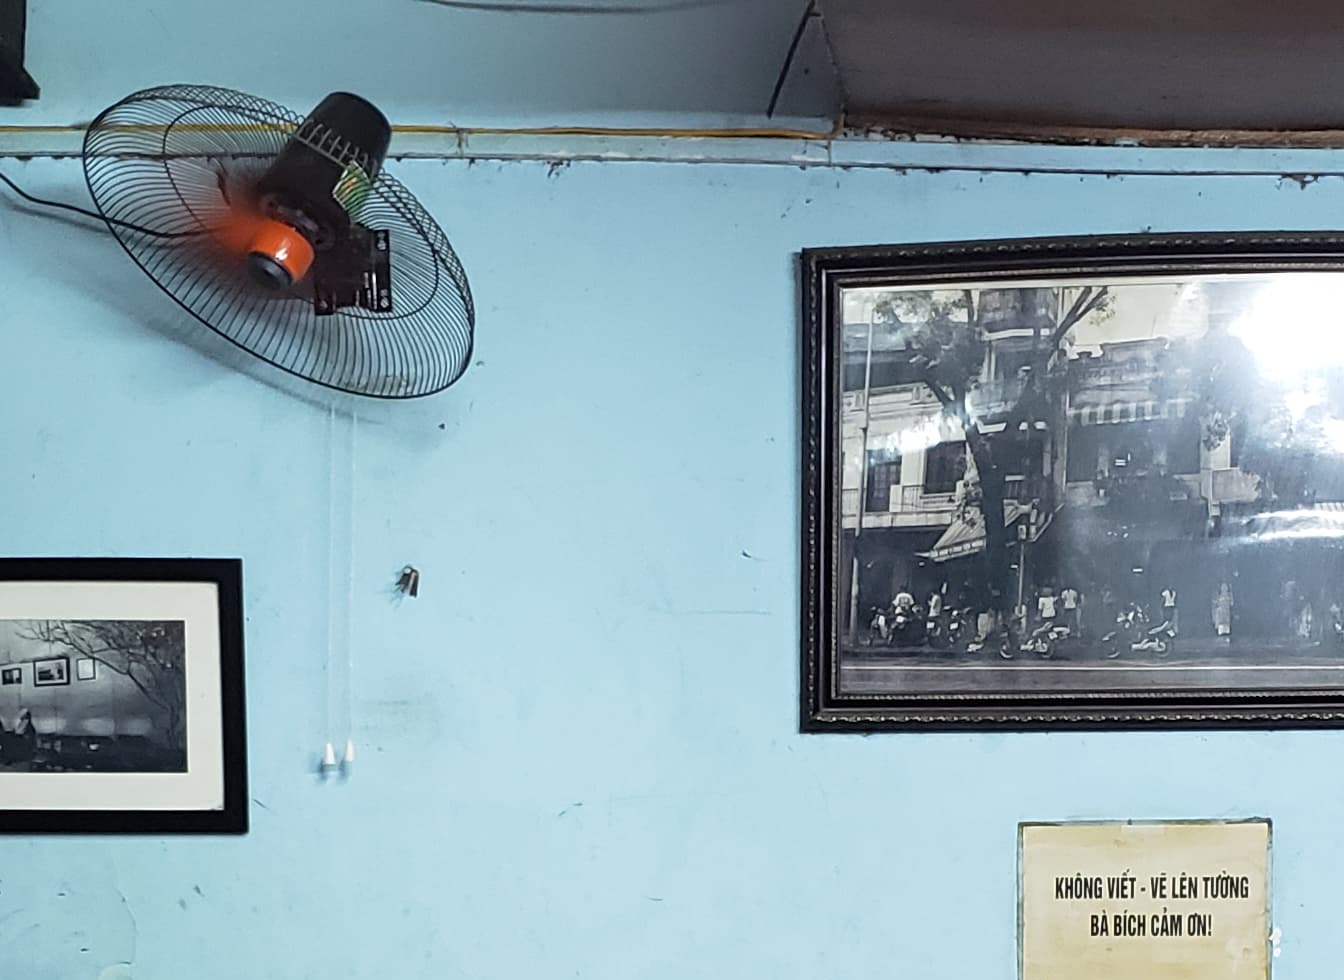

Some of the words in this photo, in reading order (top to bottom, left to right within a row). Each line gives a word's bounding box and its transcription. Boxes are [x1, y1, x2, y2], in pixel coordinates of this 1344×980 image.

[1055, 872, 1103, 899] KHÔNG
[1107, 868, 1137, 899] VIẾT
[1150, 872, 1167, 899] VẼ
[1172, 872, 1198, 899] LÊN
[1202, 869, 1249, 899] TƯỜNG
[1090, 909, 1109, 937] BÀ
[1113, 909, 1146, 937] BÍCH
[1150, 907, 1183, 937] CẢM
[1187, 912, 1212, 937] ƠN!
